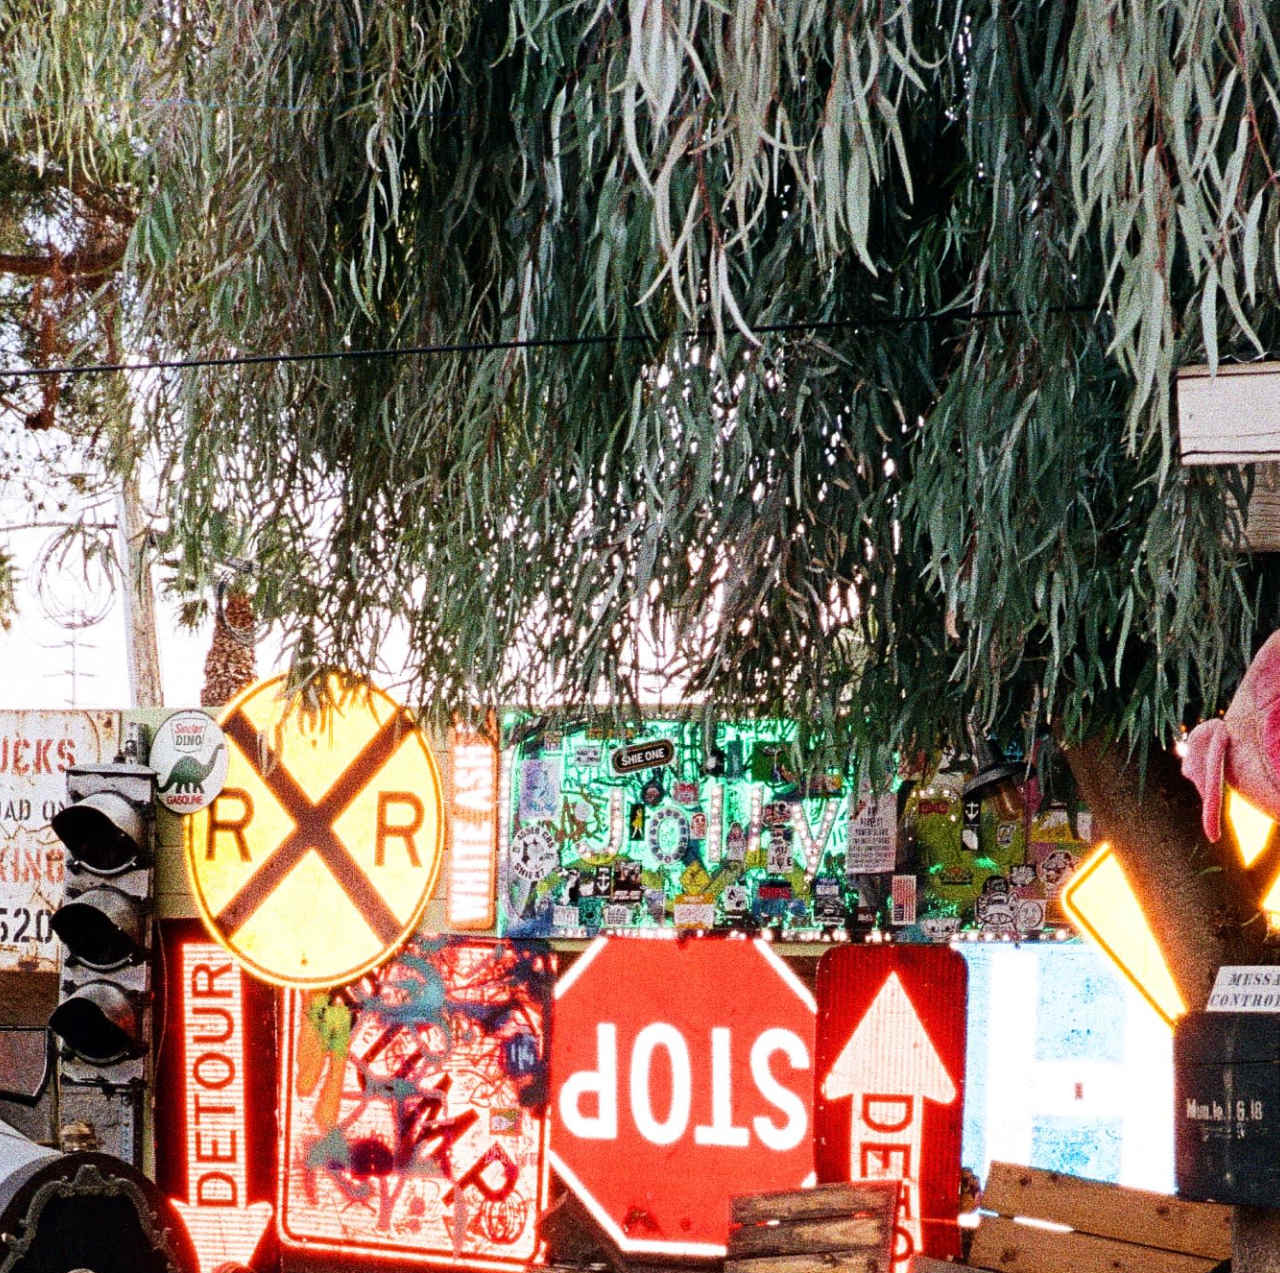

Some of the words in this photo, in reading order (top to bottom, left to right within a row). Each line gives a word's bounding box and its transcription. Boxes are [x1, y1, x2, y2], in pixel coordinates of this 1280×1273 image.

[176, 735, 202, 746] DINO
[644, 747, 665, 762] ONE
[167, 793, 203, 805] GASOLINE
[205, 790, 255, 862] R
[374, 792, 426, 867] R
[450, 820, 492, 921] WHITE
[192, 960, 238, 1208] DETOUR
[557, 1022, 811, 1151] STOP
